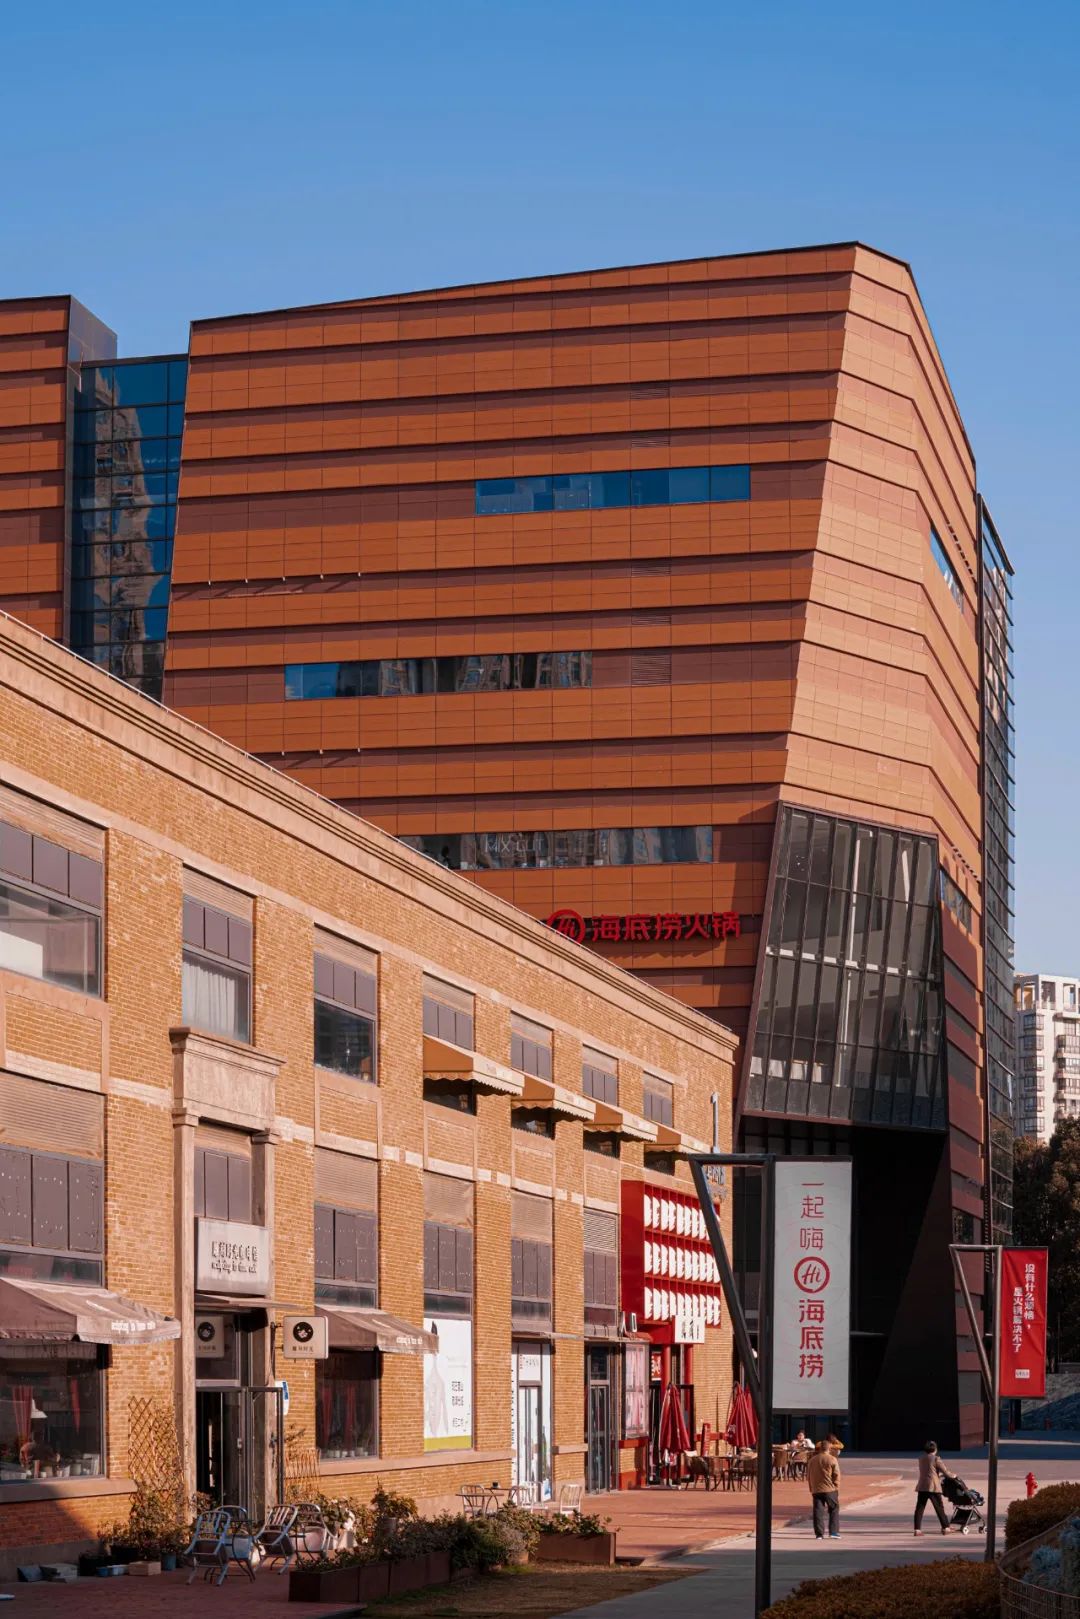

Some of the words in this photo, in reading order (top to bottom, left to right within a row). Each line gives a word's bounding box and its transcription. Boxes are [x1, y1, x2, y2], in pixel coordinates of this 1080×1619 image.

[592, 912, 740, 941] 海底捞火锅
[800, 1182, 825, 1251] 一起嗨
[799, 1298, 825, 1378] 海底捞
